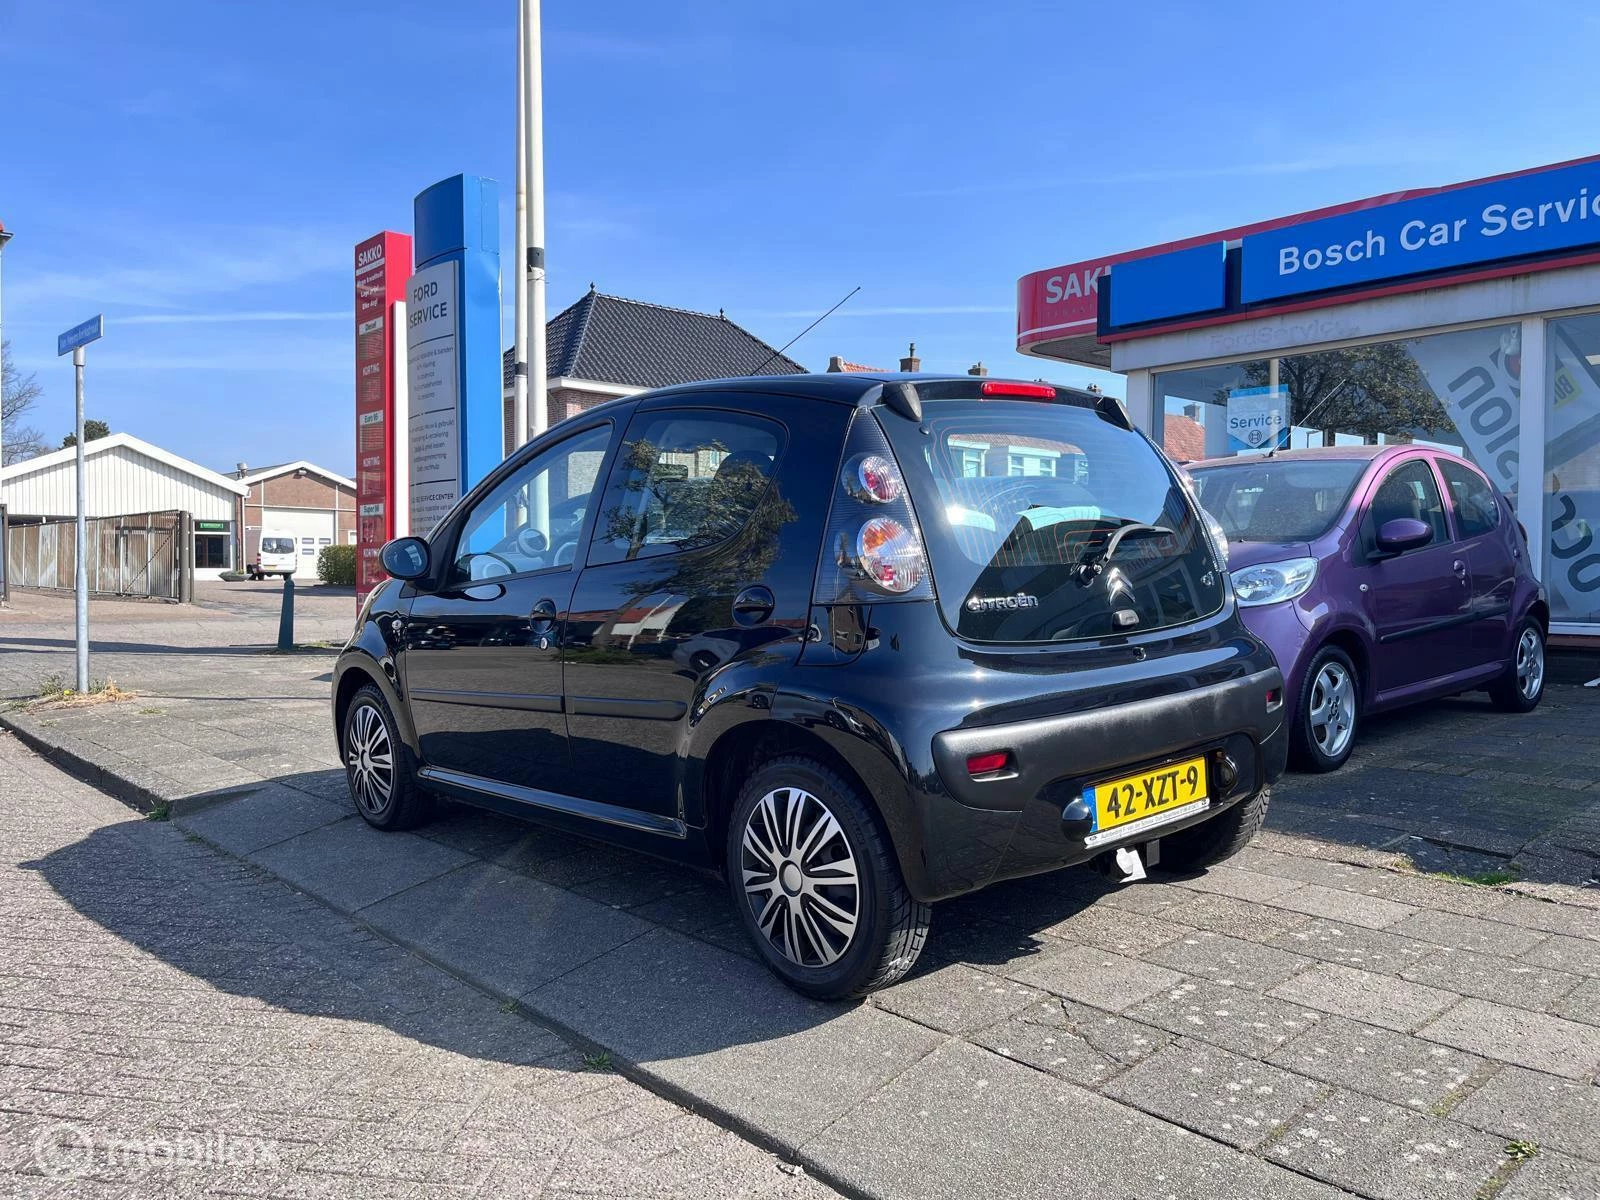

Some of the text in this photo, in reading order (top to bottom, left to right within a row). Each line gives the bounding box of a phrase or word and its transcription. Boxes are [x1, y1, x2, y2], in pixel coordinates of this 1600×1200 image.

[358, 243, 382, 267] SAKKO
[1279, 229, 1385, 276] Bosch
[1399, 217, 1467, 251] Car
[413, 281, 438, 305] FORD
[409, 301, 448, 329] SERVICE
[1230, 414, 1281, 429] Service
[1107, 765, 1199, 820] 42-XZT-9
